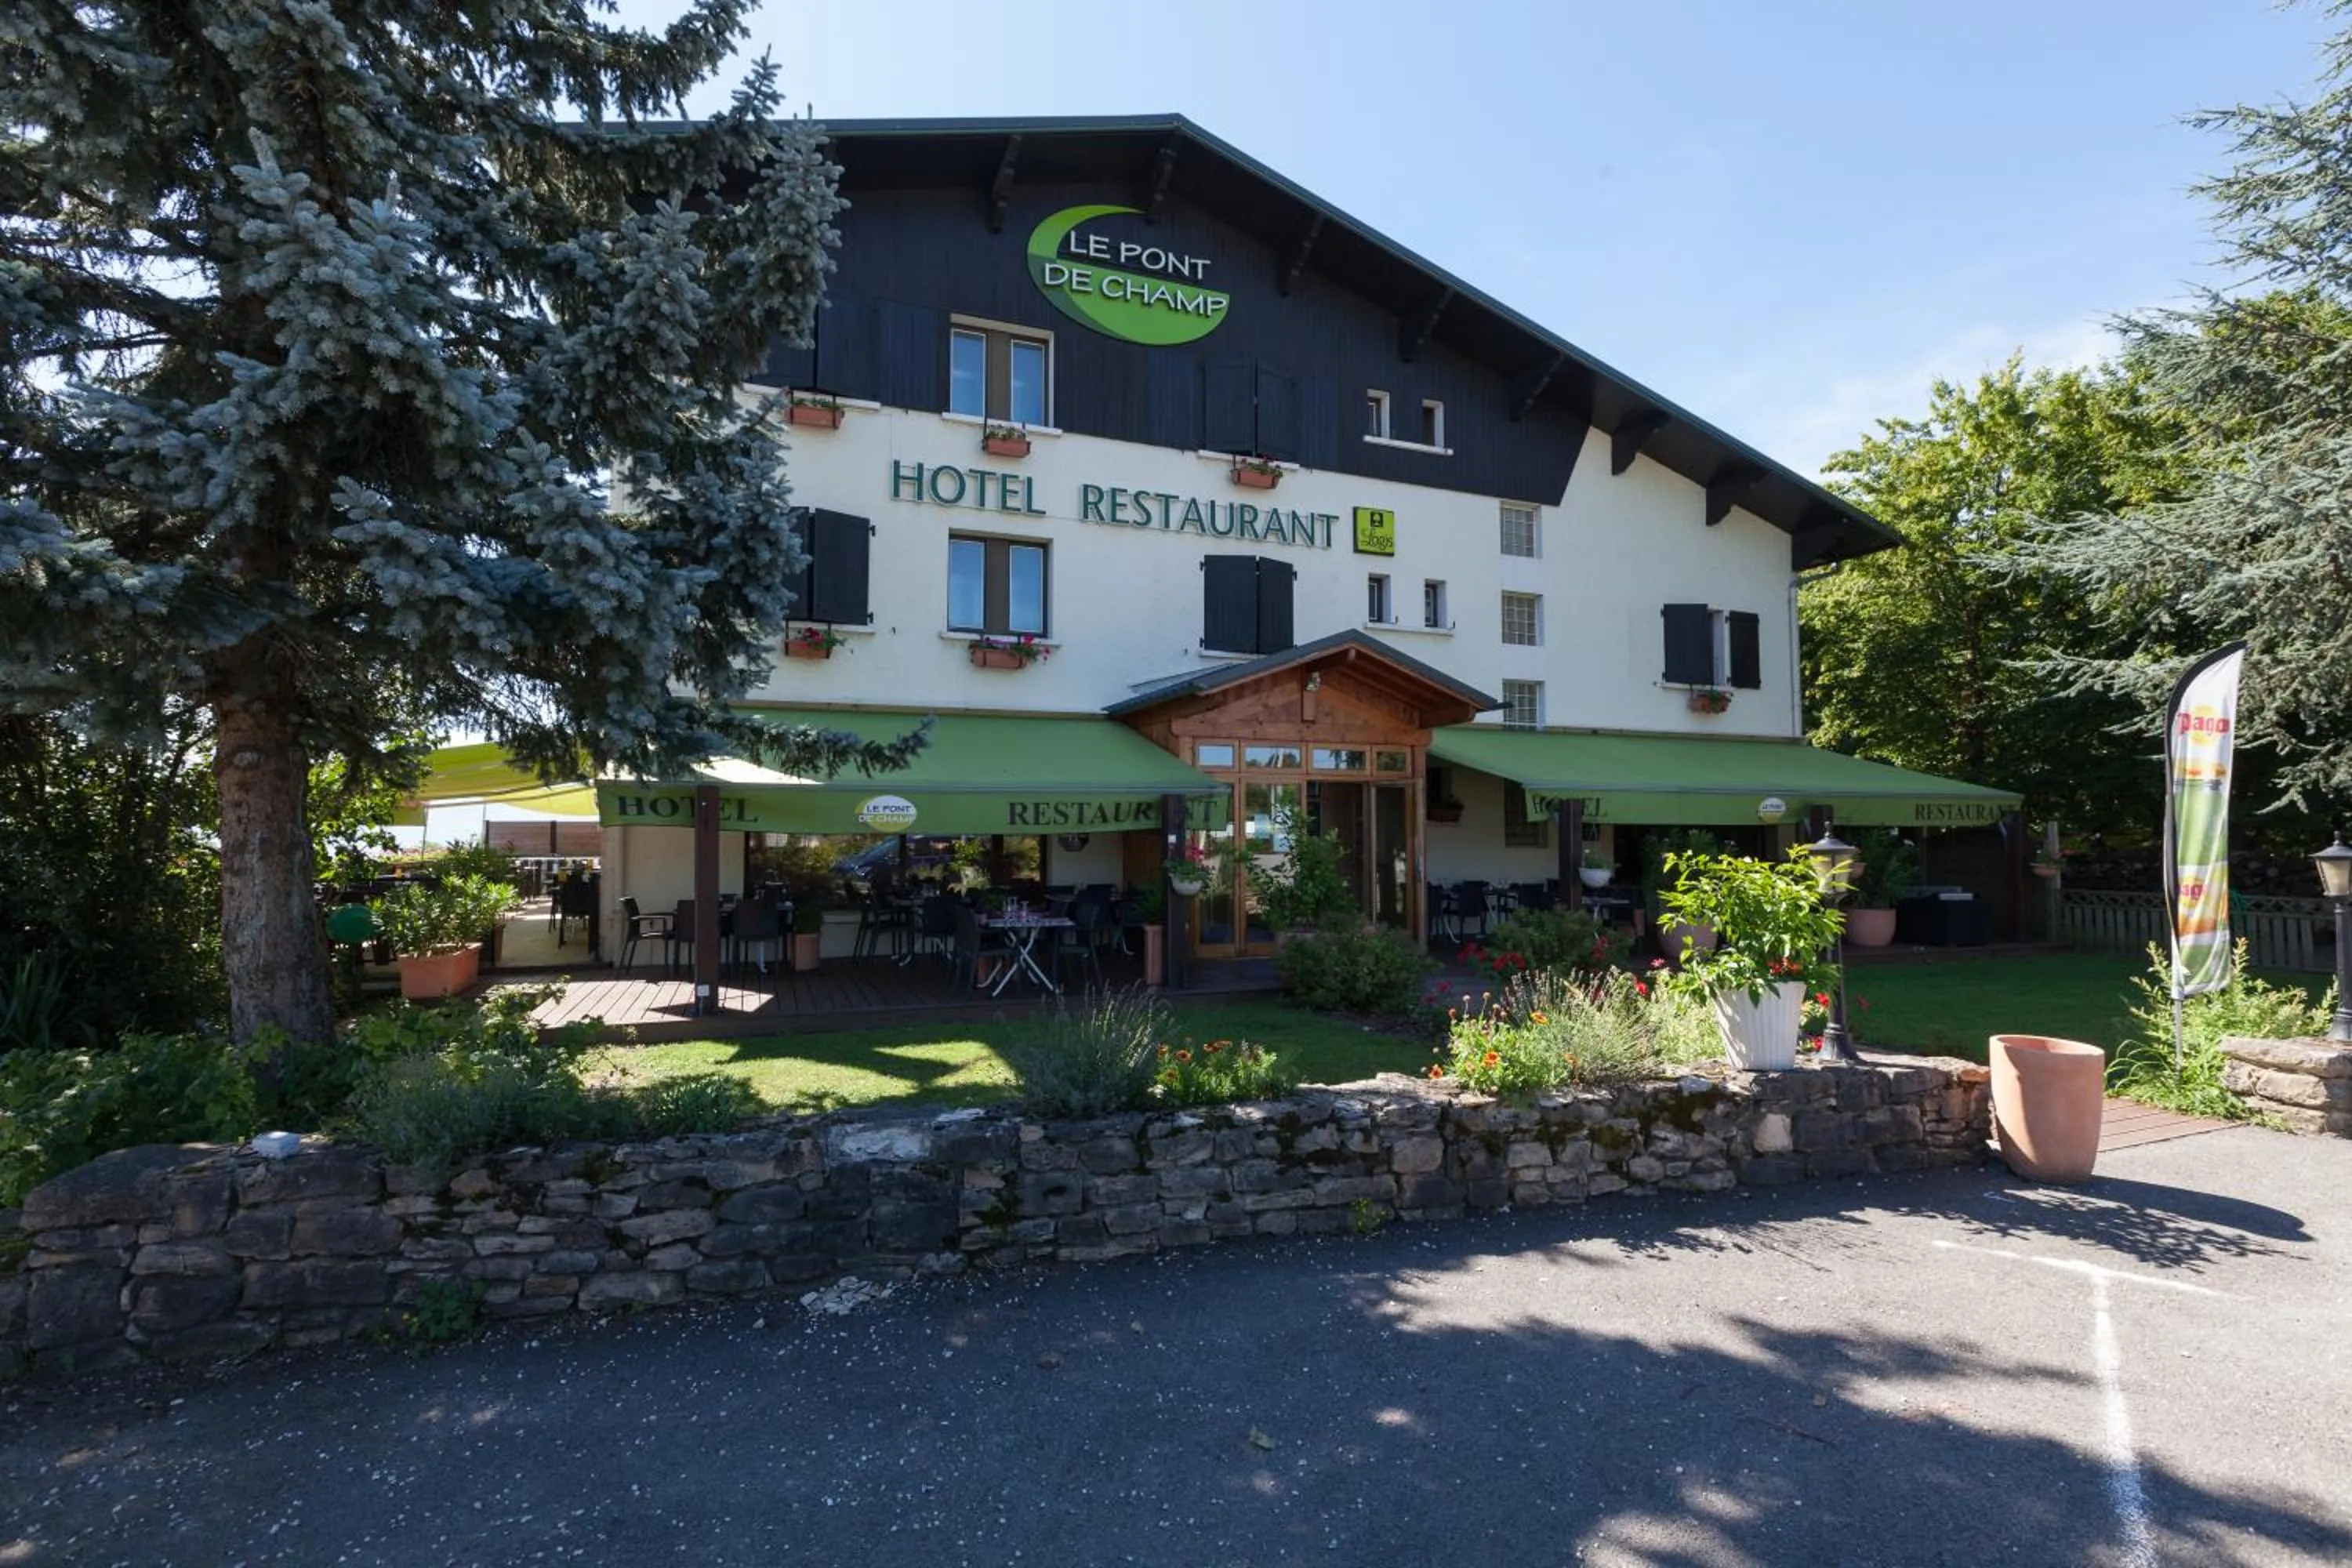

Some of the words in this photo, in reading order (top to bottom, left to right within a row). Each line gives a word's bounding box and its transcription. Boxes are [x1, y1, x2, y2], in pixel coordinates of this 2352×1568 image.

[1069, 230, 1111, 260] LE
[1120, 241, 1211, 280] PONT
[1044, 263, 1094, 292] DE
[1101, 275, 1227, 317] CHAMP
[891, 459, 1047, 517] HOTEL
[1080, 483, 1340, 549] RESTAURANT
[1008, 800, 1218, 826] RESTAURNT
